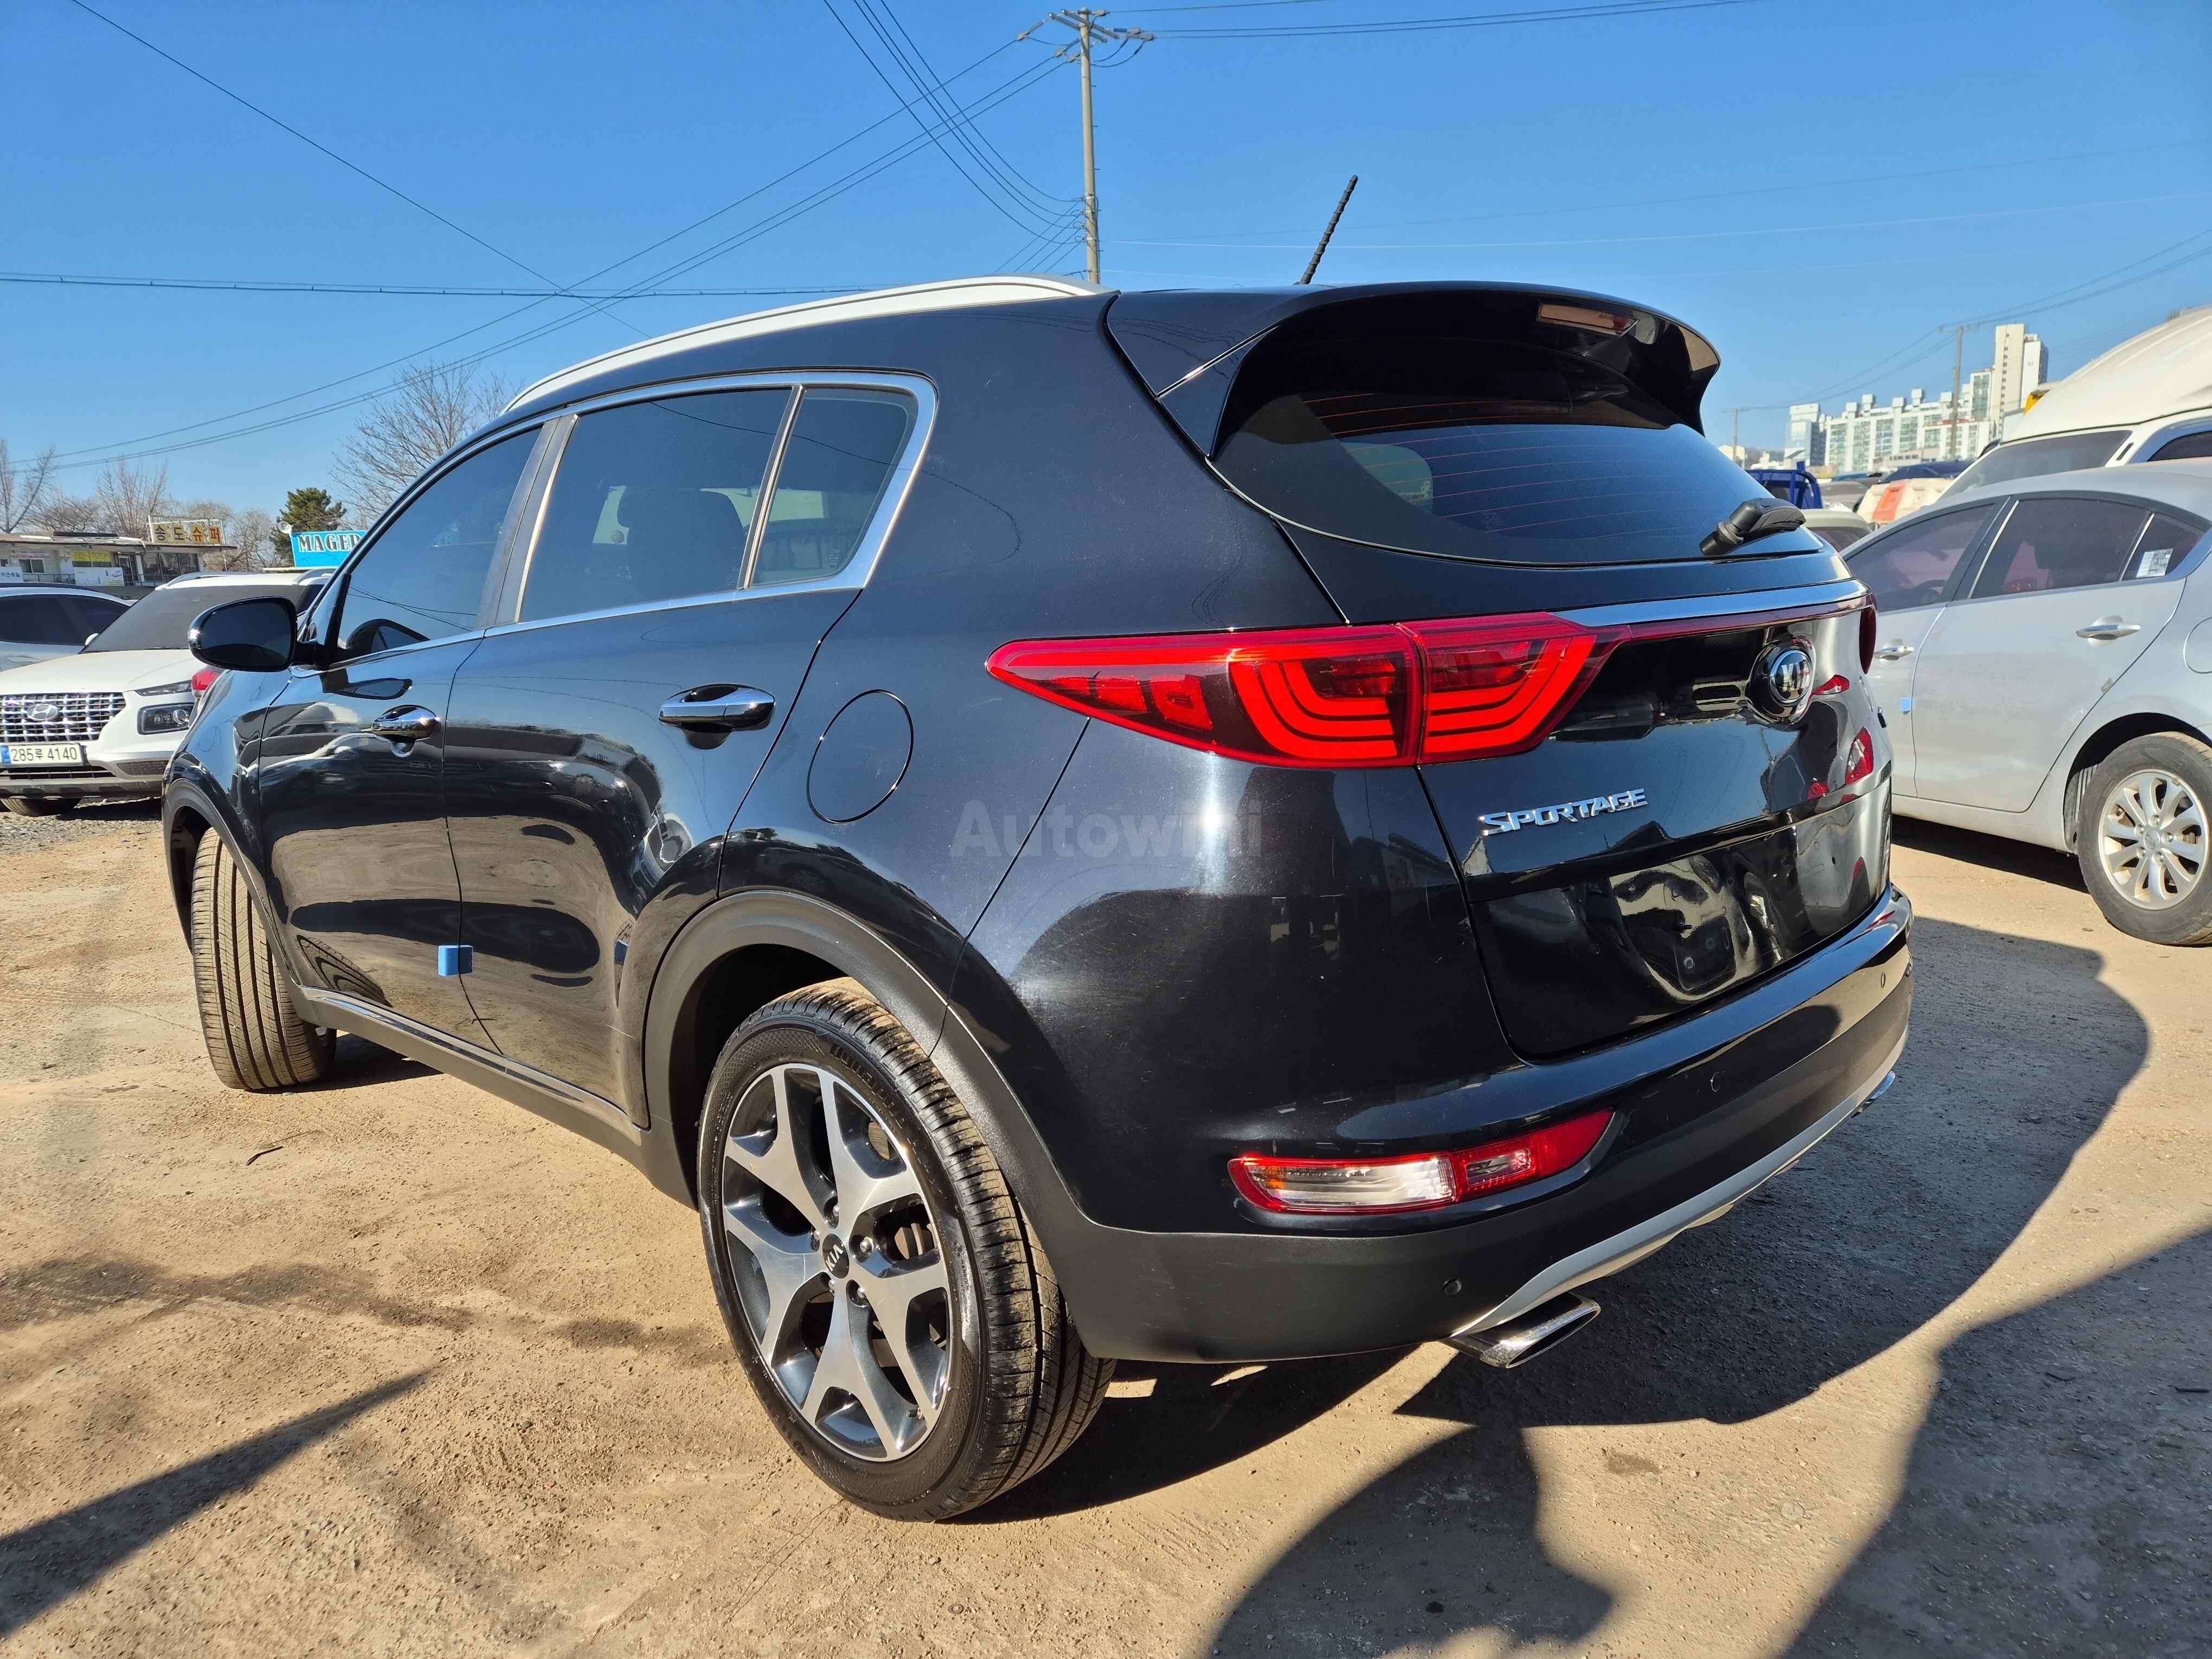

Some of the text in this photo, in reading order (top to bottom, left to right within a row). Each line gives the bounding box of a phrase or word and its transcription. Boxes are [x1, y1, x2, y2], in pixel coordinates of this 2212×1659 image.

[48, 747, 78, 760] 4140
[1478, 788, 1649, 836] SPORTAGE
[825, 1244, 844, 1272] KIA
